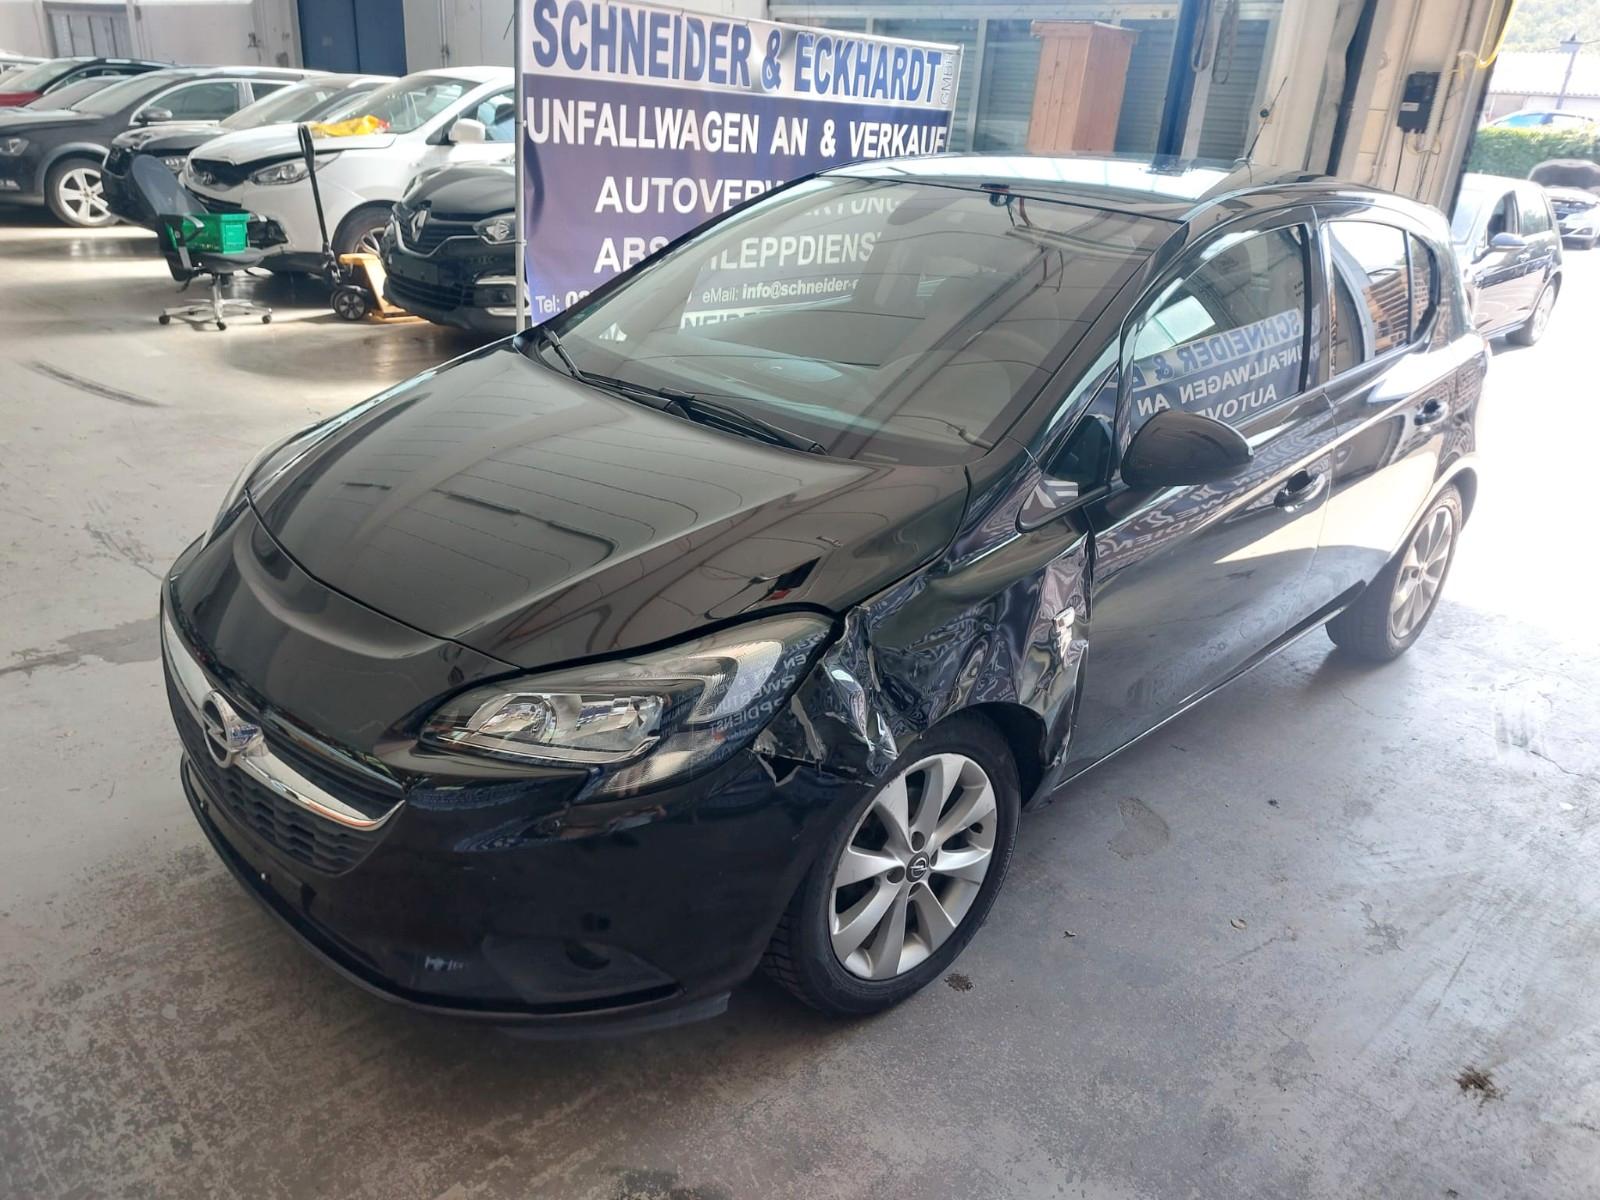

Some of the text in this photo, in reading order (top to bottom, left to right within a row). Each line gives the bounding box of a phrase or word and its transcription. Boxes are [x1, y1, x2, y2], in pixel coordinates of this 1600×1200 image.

[532, 0, 942, 104] SCHNEIDER & ECKHARDT
[526, 96, 948, 158] UNFALLWAGEN AN & VERKAUF
[535, 294, 560, 314] Tel:
[702, 286, 738, 304] eMail:
